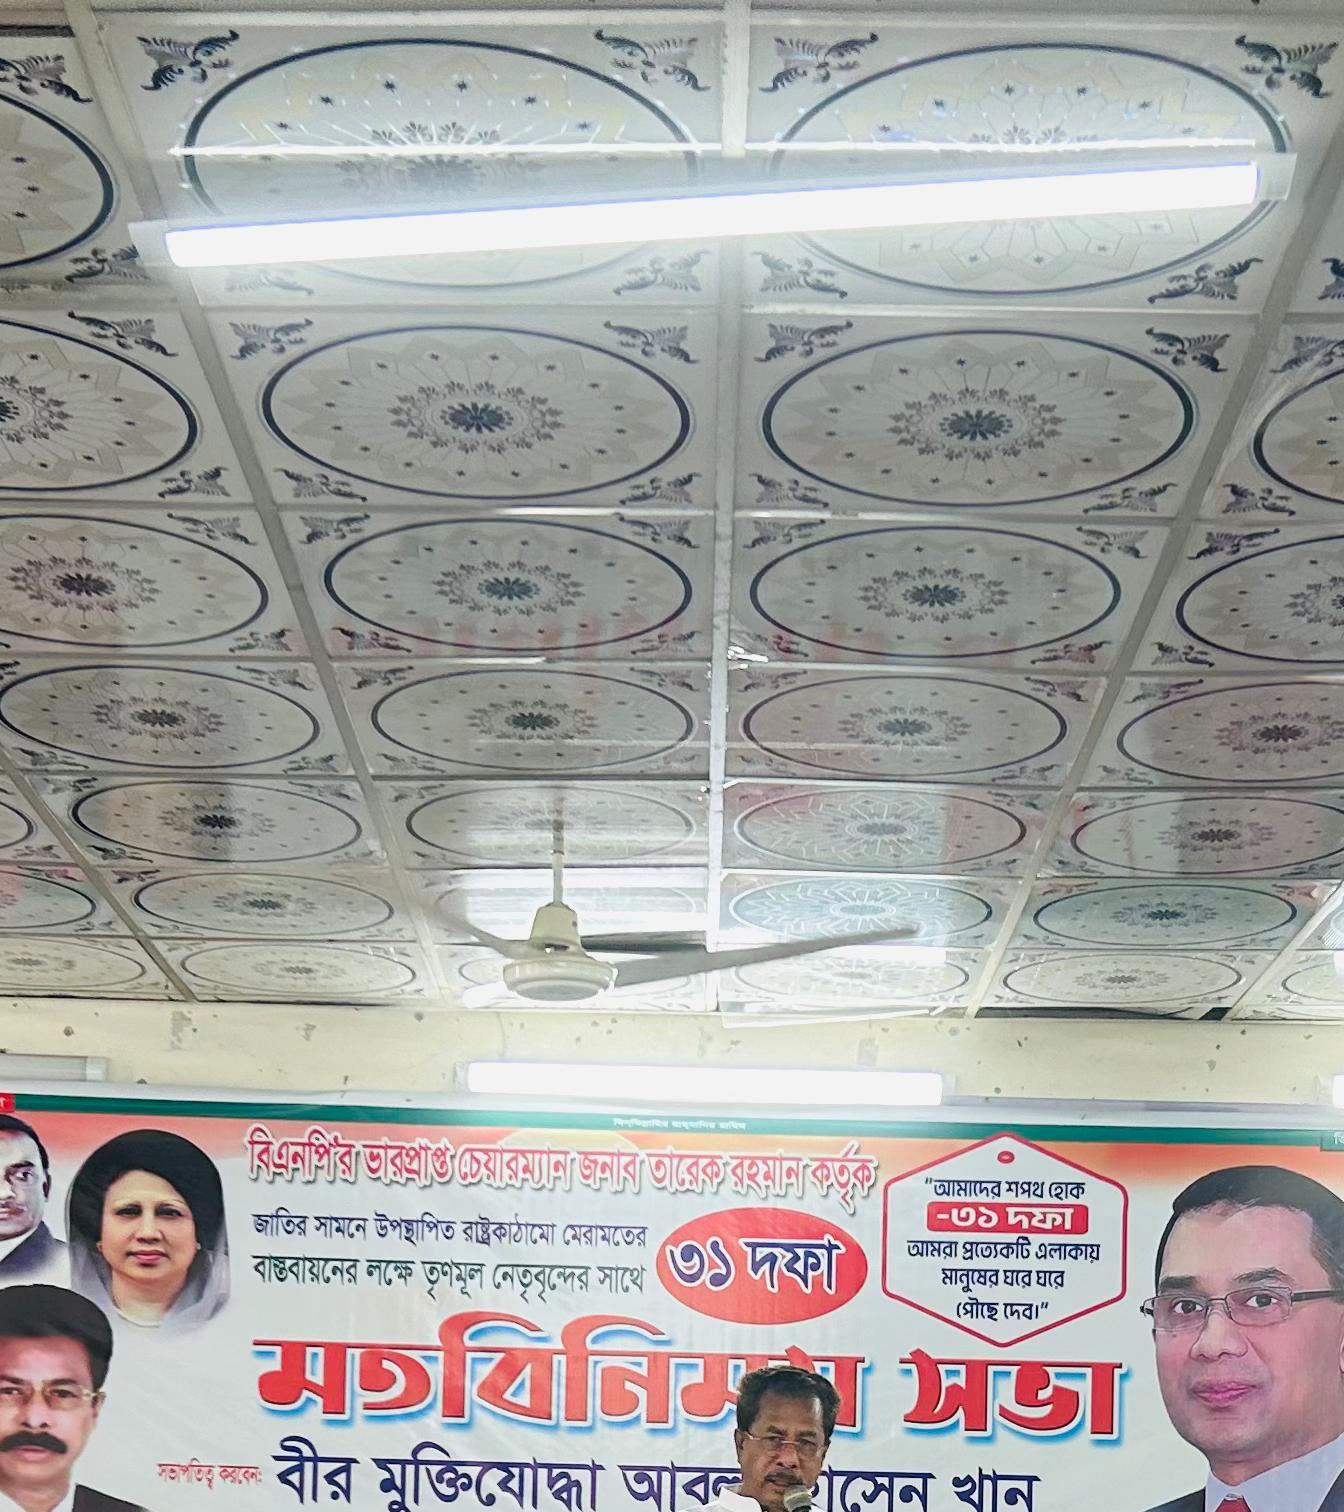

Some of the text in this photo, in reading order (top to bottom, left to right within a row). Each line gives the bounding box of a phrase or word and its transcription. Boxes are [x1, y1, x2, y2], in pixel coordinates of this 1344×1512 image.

[361, 1138, 455, 1187] ভারপ্রাপ্ত
[458, 1145, 570, 1190] চেয়ারম্যান
[574, 1148, 642, 1193] জনাব
[644, 1146, 725, 1193] তারেক
[727, 1150, 806, 1198] রহমান
[807, 1140, 877, 1215] কর্তৃক
[1006, 1180, 1045, 1199] শপথ
[1048, 1182, 1086, 1200] হোক
[252, 1207, 648, 1248] জাতির সামনে উপস্থাপিত রাষ্ট্রকাঠামো মেরামতের
[1005, 1207, 1074, 1230] দফা
[667, 1237, 842, 1291] ৩১ দফা
[907, 1236, 1101, 1263] আমরা প্রত্যেকটি এলাকায়
[252, 1254, 360, 1285] বাস্তবায়নের
[422, 1261, 485, 1300] তৃণমূল
[492, 1264, 591, 1303] নেতৃবৃন্দের
[597, 1264, 648, 1294] সাথে
[942, 1268, 1065, 1292] মানুষের ঘরে ঘরে
[900, 1347, 1122, 1437] সভা
[271, 1435, 359, 1504] বীর
